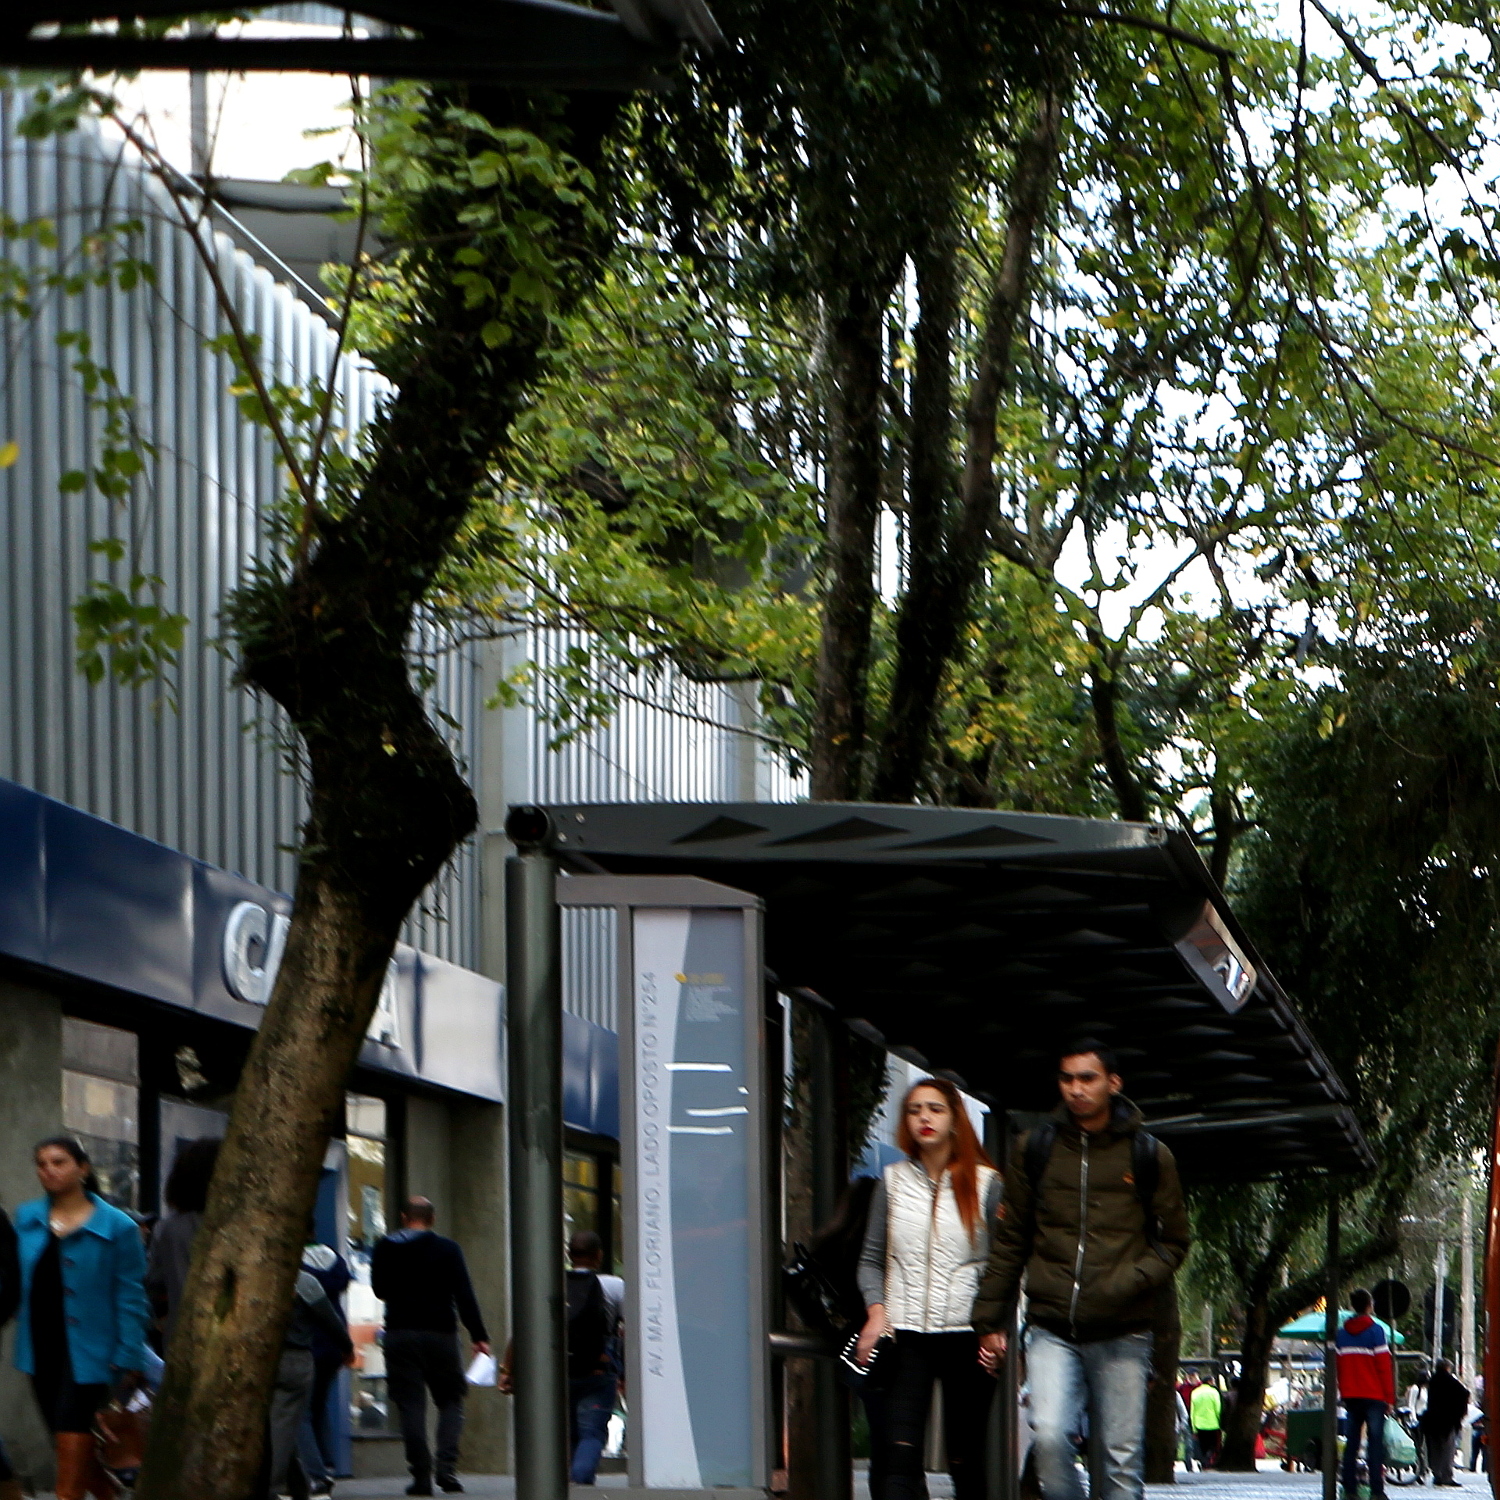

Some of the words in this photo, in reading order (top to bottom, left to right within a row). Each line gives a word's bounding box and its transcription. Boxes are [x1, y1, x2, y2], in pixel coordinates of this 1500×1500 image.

[642, 1033, 659, 1117] OPOSTO
[643, 1122, 660, 1177] LADO
[647, 1296, 663, 1344] MAL.
